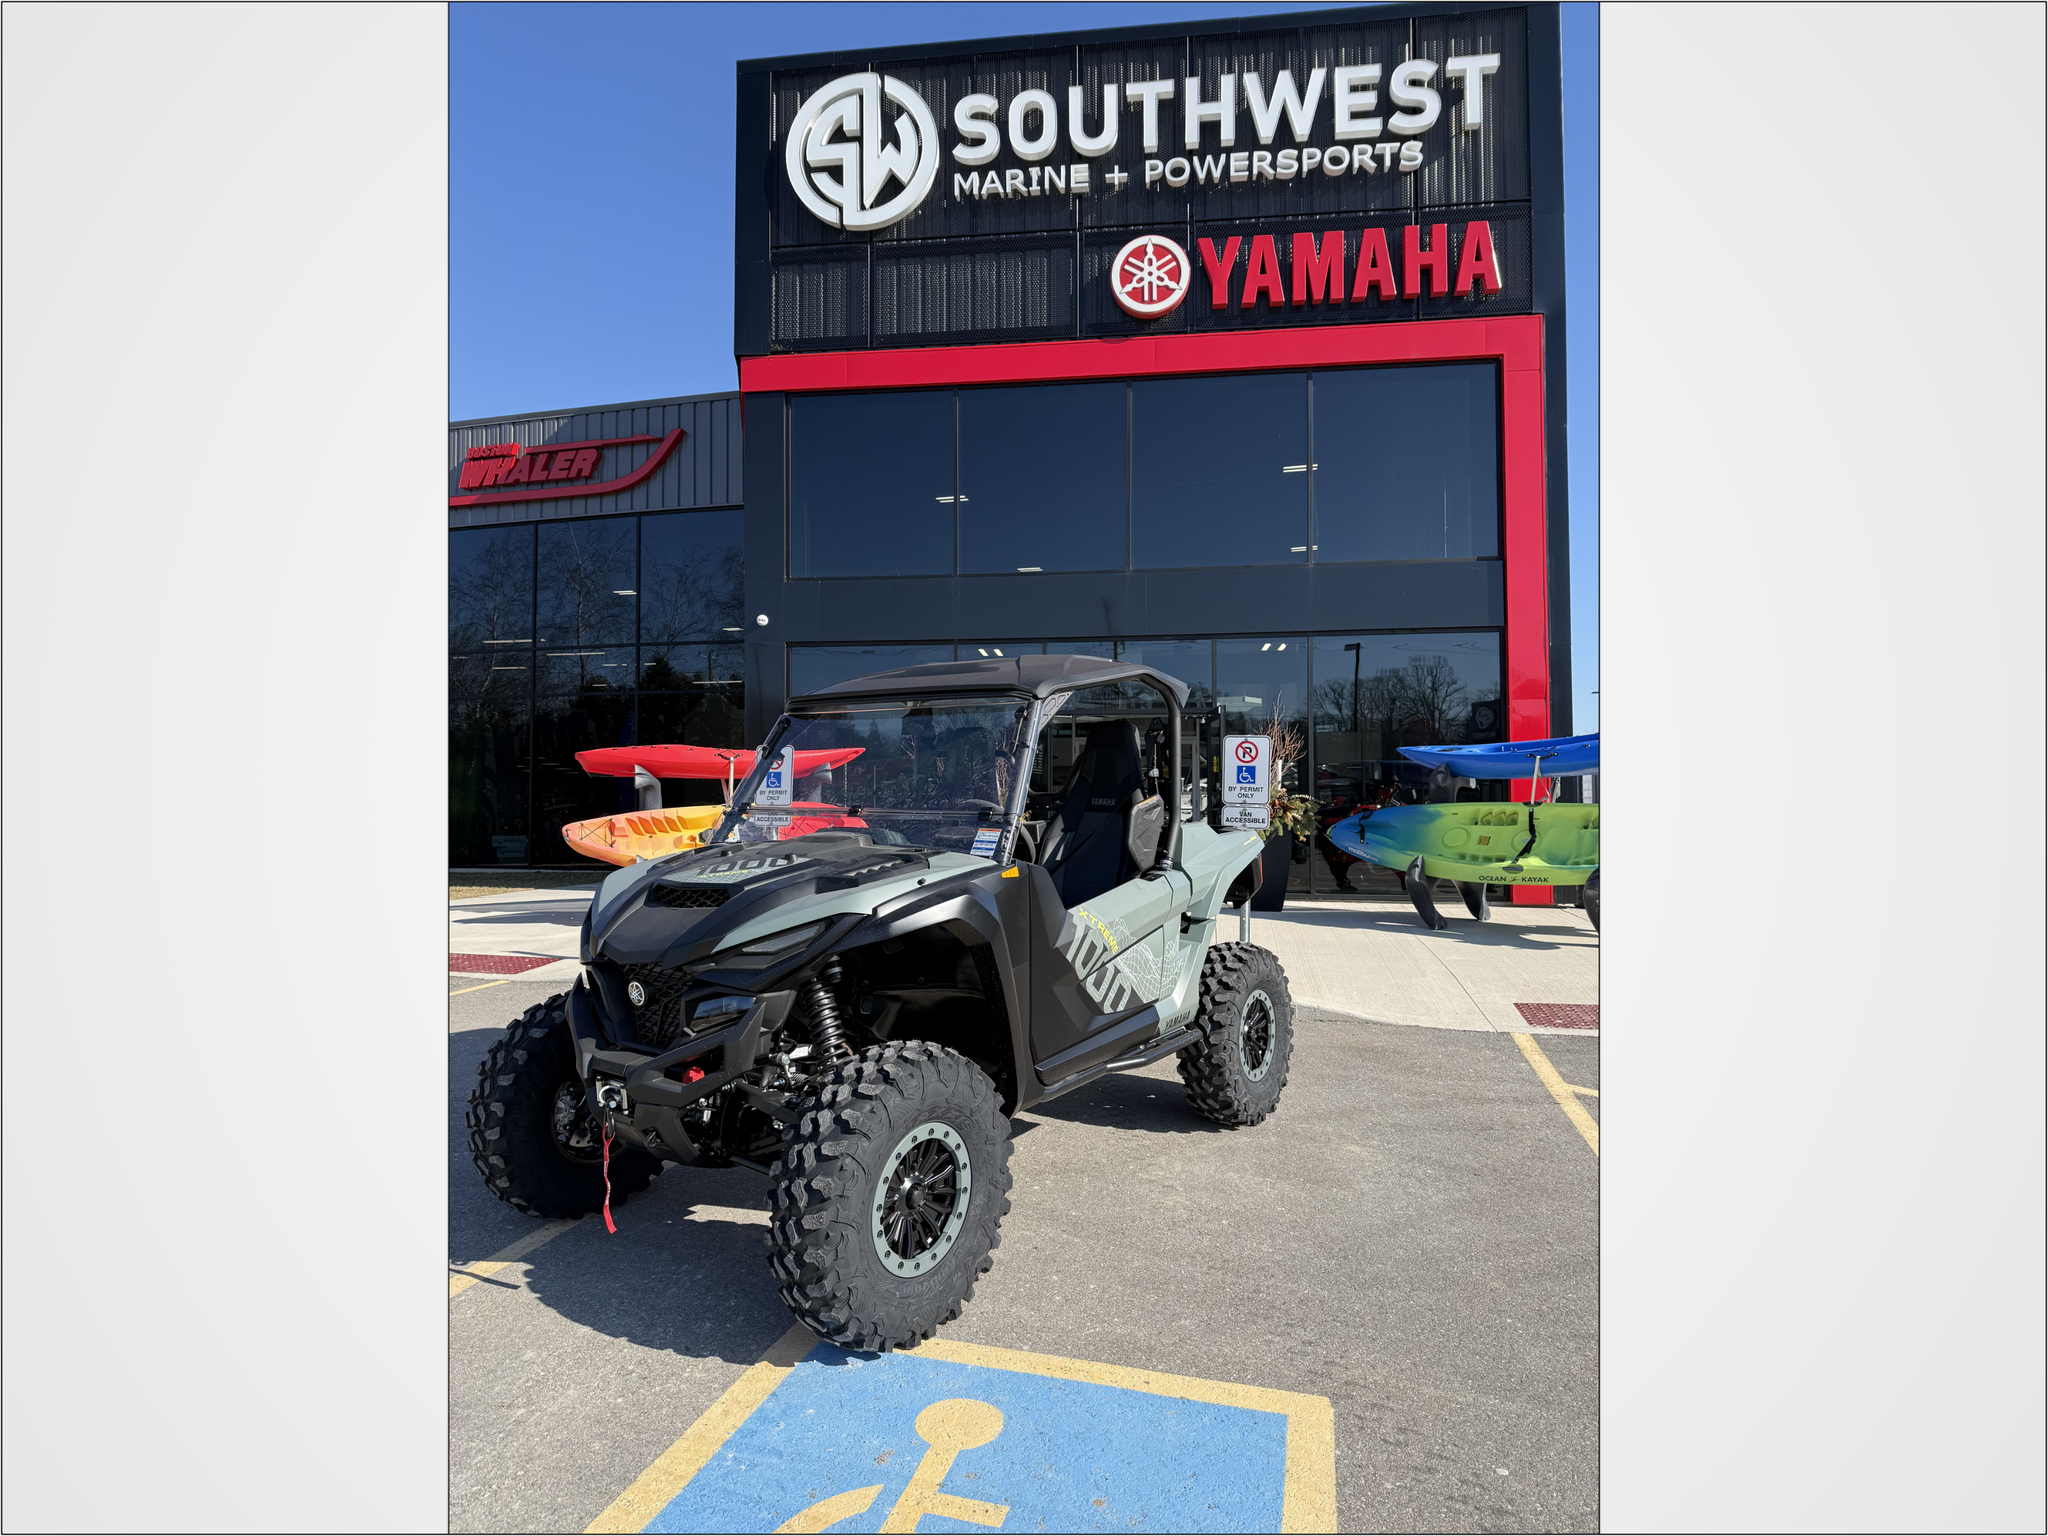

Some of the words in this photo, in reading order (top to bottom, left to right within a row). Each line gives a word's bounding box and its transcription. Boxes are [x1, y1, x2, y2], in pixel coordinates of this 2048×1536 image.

[952, 53, 1501, 165] SOUTHWEST
[953, 163, 1090, 201] MARINE
[1145, 140, 1424, 189] POWERSPORTS
[1197, 220, 1502, 310] YAMAHA
[458, 448, 600, 489] WHALER
[465, 442, 520, 460] BOSTON
[1091, 797, 1116, 806] YAMAHA
[1078, 907, 1119, 955] XTREME
[1065, 908, 1132, 1014] 1000
[1164, 1010, 1191, 1031] YAMAHA
